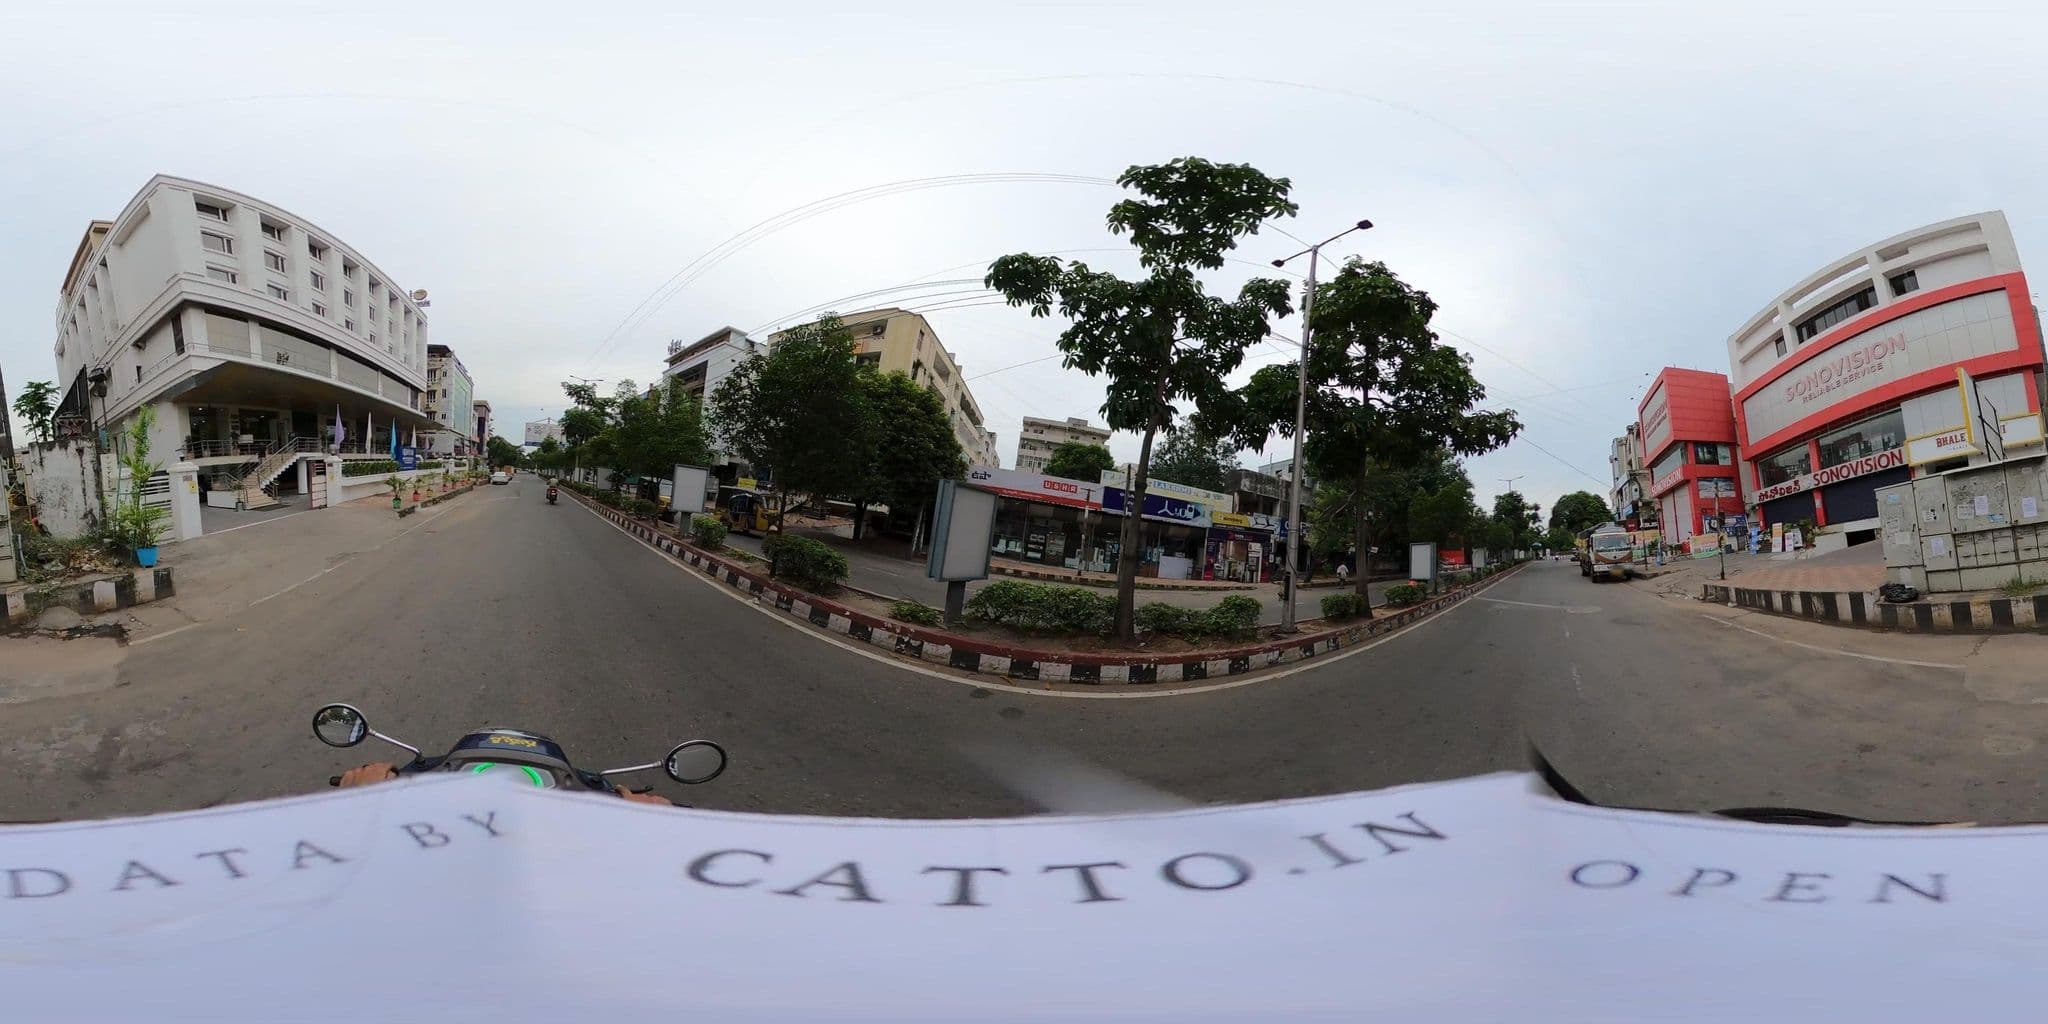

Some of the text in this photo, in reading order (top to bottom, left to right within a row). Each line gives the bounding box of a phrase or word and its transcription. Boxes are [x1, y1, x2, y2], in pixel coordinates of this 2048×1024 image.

[1786, 331, 1906, 402] SONOVISION
[1803, 362, 1884, 404] RELIABLE SERVICE
[1936, 432, 1966, 447] BHALE
[1044, 480, 1078, 493] USHA
[1651, 467, 1681, 496] SONOVISION
[1813, 449, 1904, 487] SONOVISION
[5, 810, 505, 899] DATA BY
[684, 810, 1448, 907] CATTO.IN
[1568, 859, 1951, 904] OPEN
